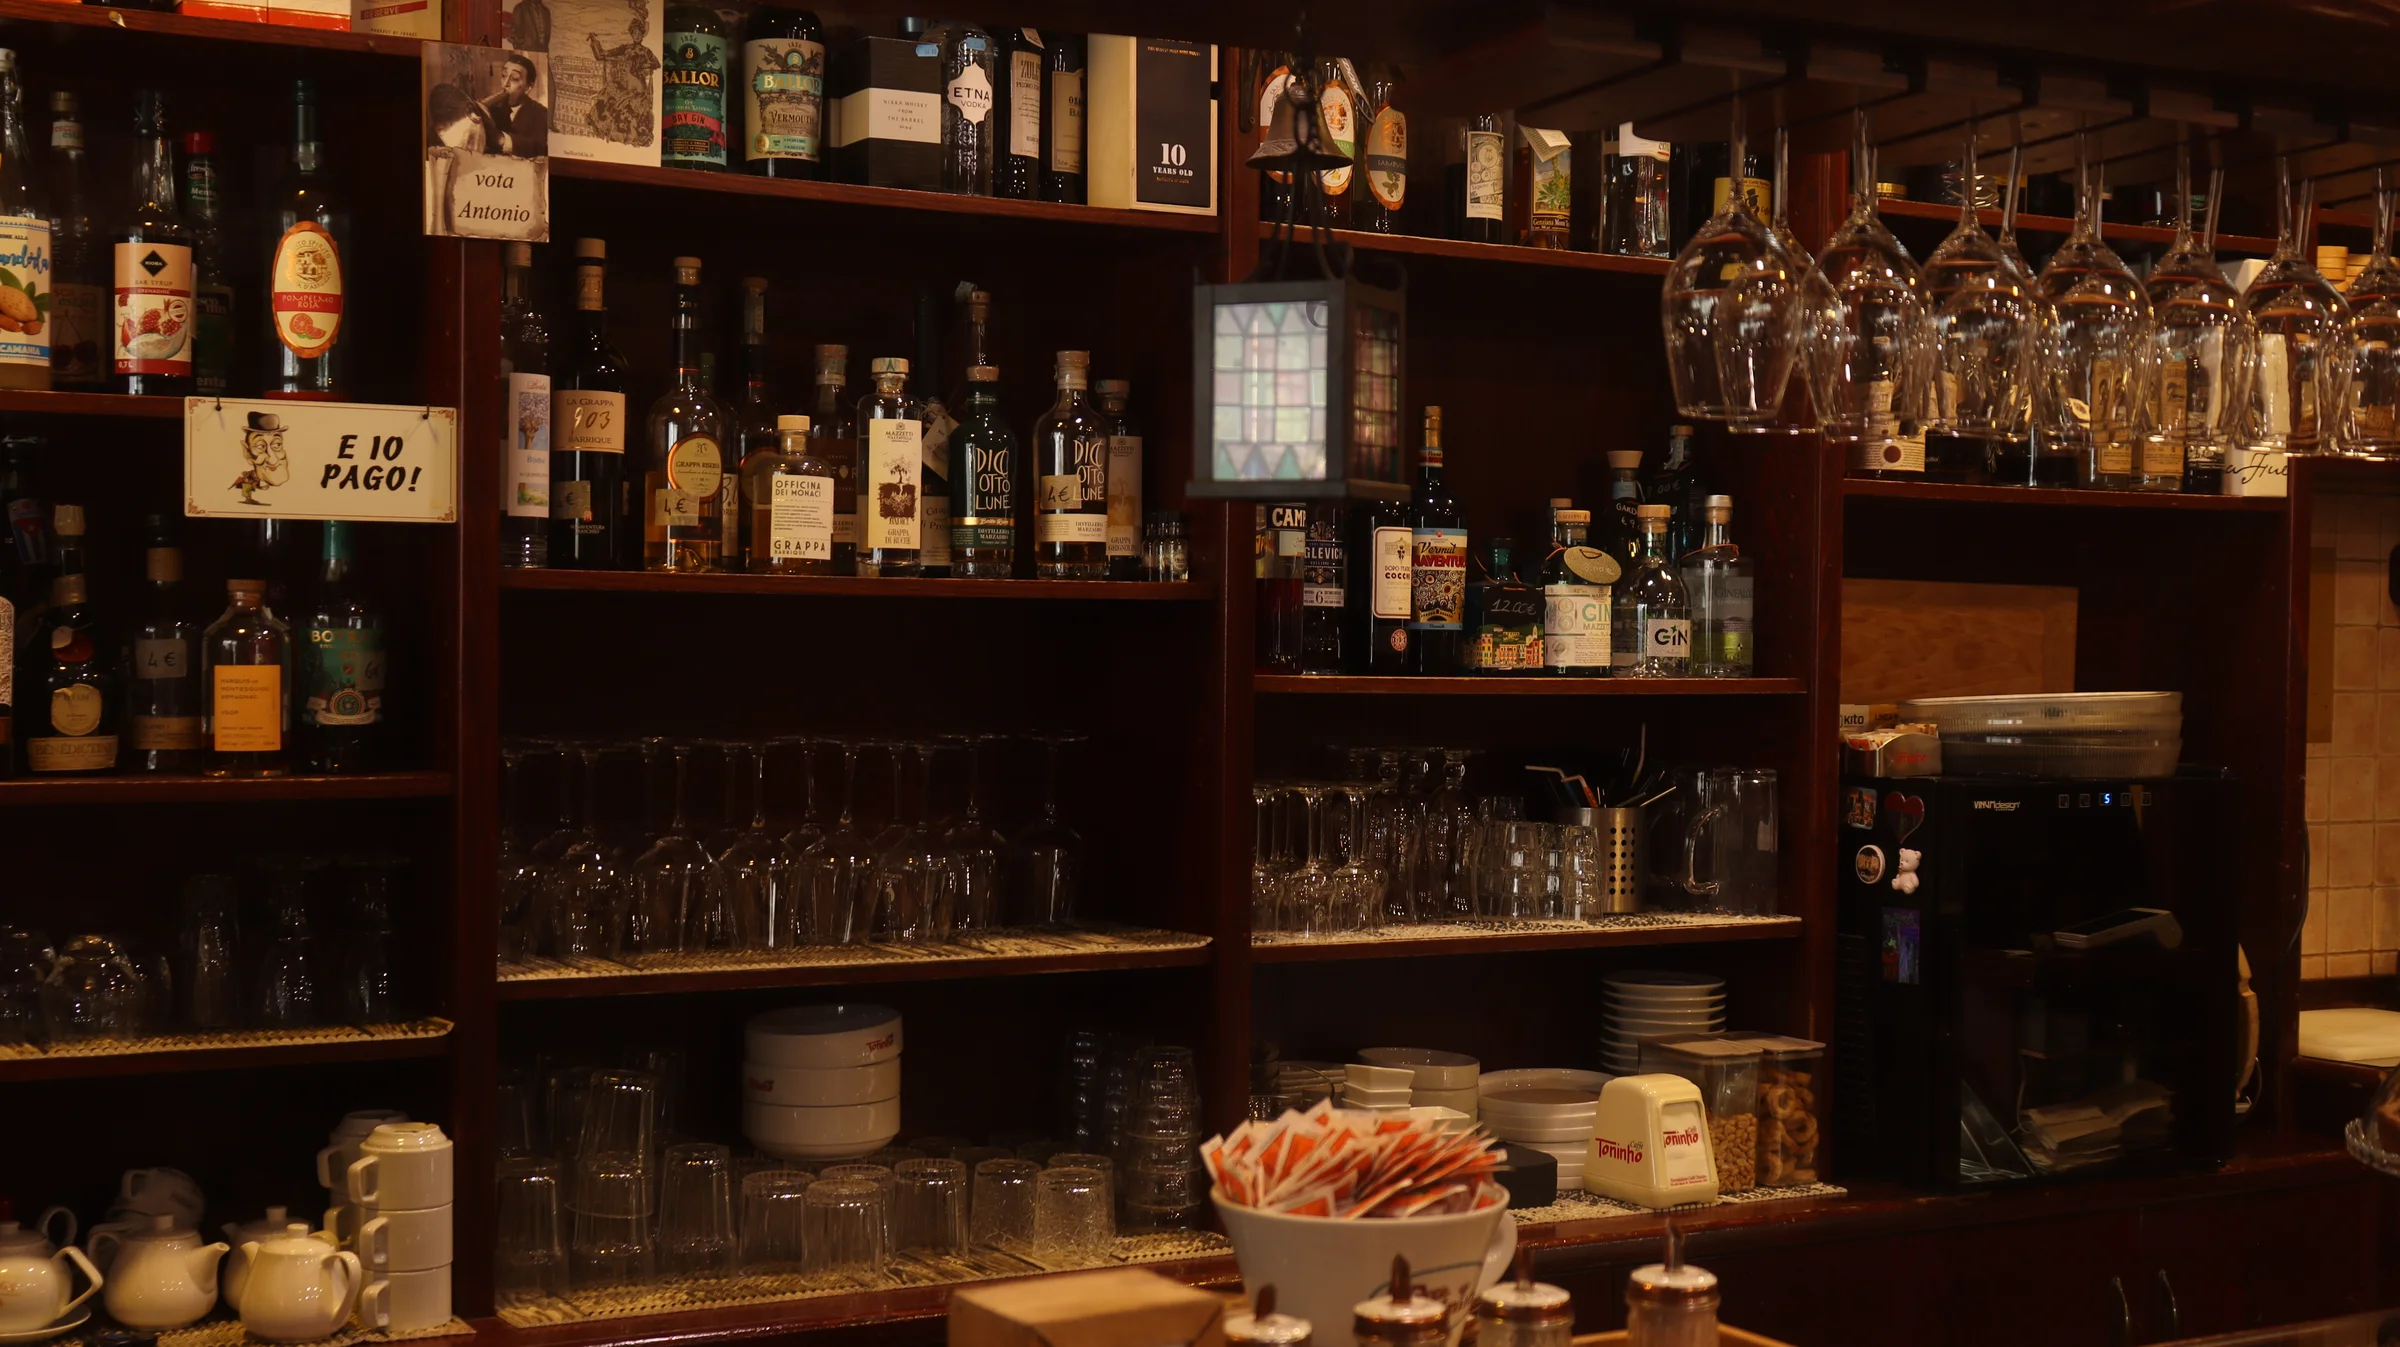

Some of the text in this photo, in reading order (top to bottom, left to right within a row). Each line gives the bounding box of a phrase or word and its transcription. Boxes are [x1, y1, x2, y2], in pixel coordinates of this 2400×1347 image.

[763, 75, 820, 93] BALLOR
[953, 86, 990, 102] ETNA
[960, 100, 987, 109] VODKA
[671, 112, 706, 125] DRY GIN
[1160, 142, 1187, 167] 10
[1152, 165, 1194, 177] YEARS OLD
[475, 173, 515, 189] vota
[458, 200, 531, 222] Antonio
[282, 294, 334, 304] POMPELMO
[297, 301, 320, 309] ROSA
[566, 397, 615, 407] LA GRAPPA
[571, 406, 611, 432] 903
[337, 433, 404, 461] E IO
[320, 463, 422, 492] PAGO!
[1076, 465, 1105, 485] OTTO
[775, 480, 821, 490] OFFICINA
[979, 473, 1011, 494] OTTO
[790, 489, 822, 498] MONACI
[1073, 485, 1105, 501] LUNE
[975, 494, 1012, 510] LUNE
[773, 540, 826, 552] GRAPPA
[1417, 541, 1457, 555] Vermut
[1315, 589, 1324, 605] 6
[1581, 603, 1611, 622] GIN
[1654, 625, 1688, 646] GIN
[1663, 1129, 1699, 1149] Toninho
[1594, 1137, 1644, 1164] Toninho
